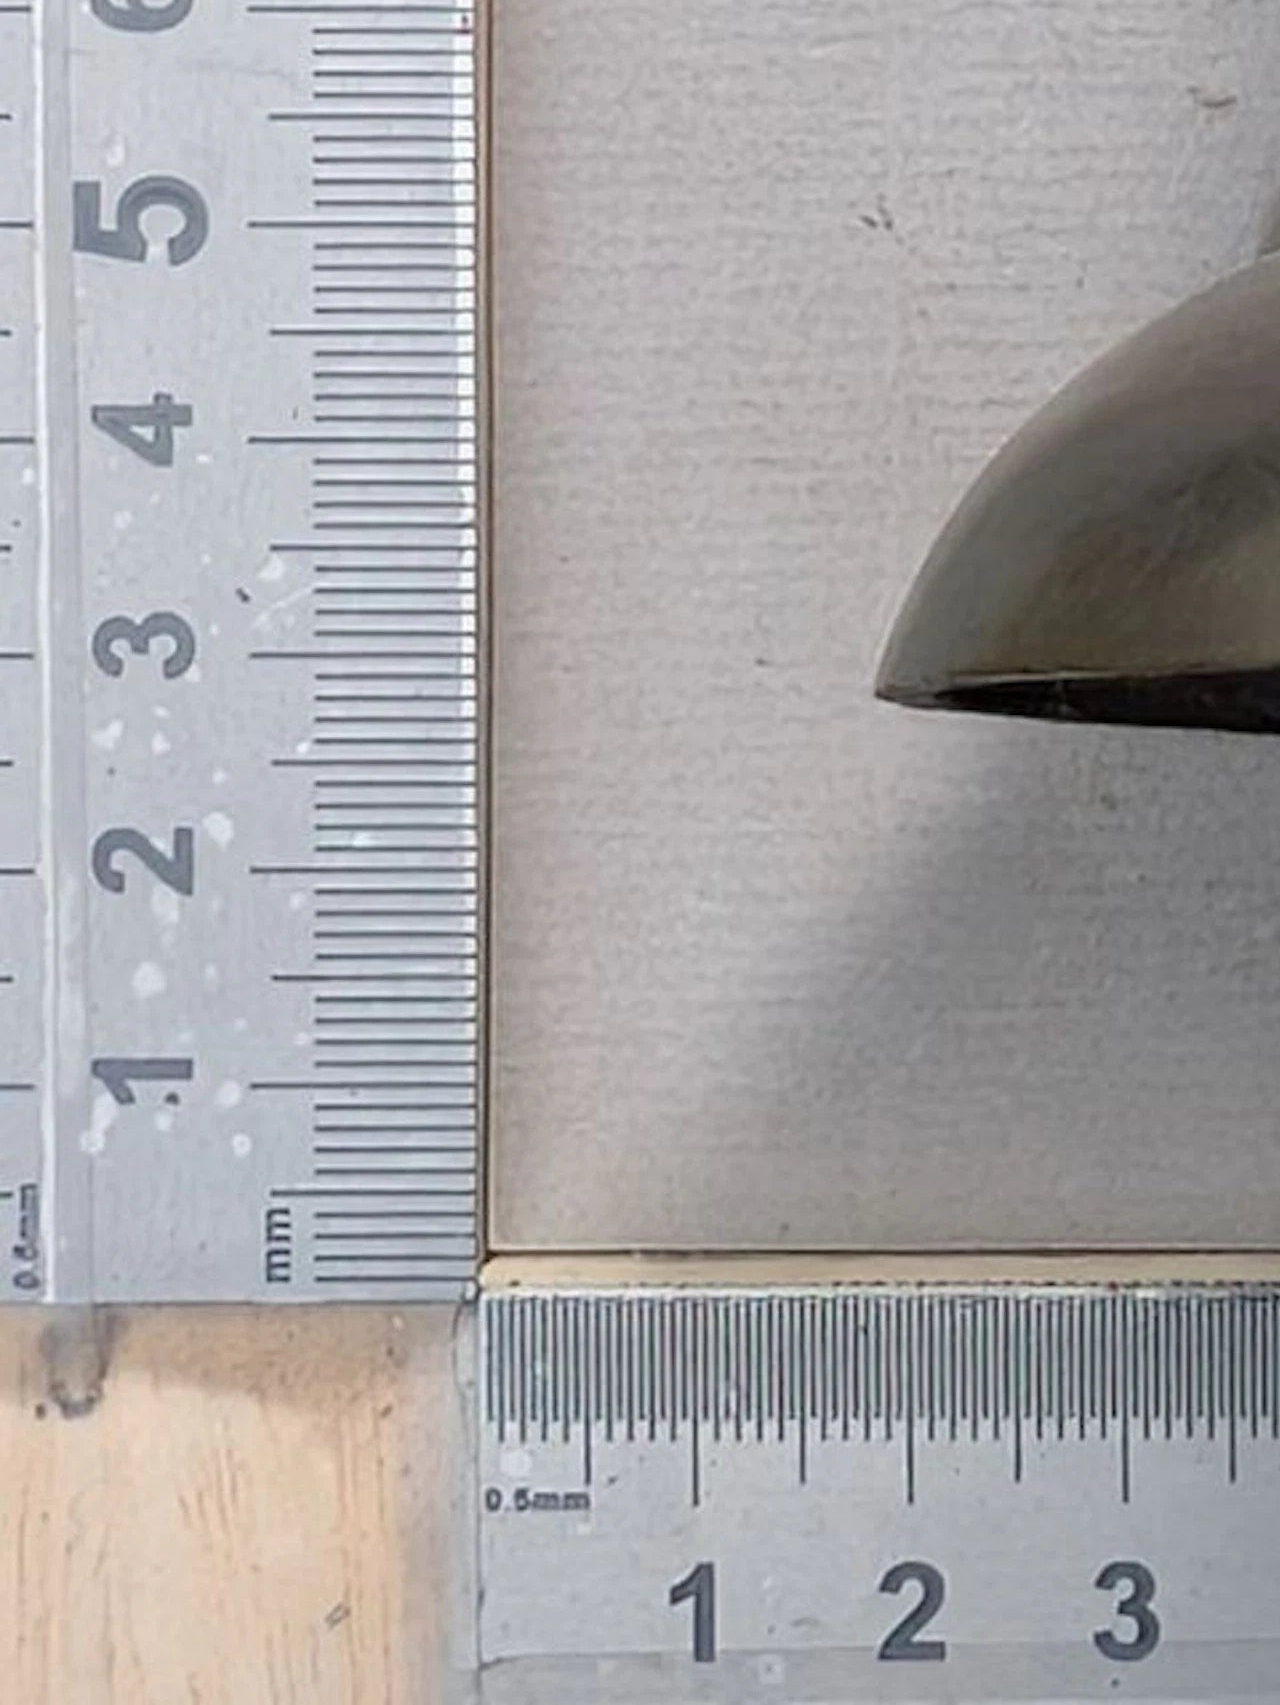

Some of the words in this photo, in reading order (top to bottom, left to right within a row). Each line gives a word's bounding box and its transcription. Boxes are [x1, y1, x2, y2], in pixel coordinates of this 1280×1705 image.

[73, 175, 210, 266] 5
[91, 393, 193, 466] 4
[92, 611, 195, 679] 3
[93, 826, 194, 896] 2
[91, 1057, 194, 1105] 1
[266, 1207, 291, 1283] mm
[669, 1562, 716, 1662] 1
[877, 1560, 947, 1663] 2
[1092, 1560, 1160, 1661] 3
